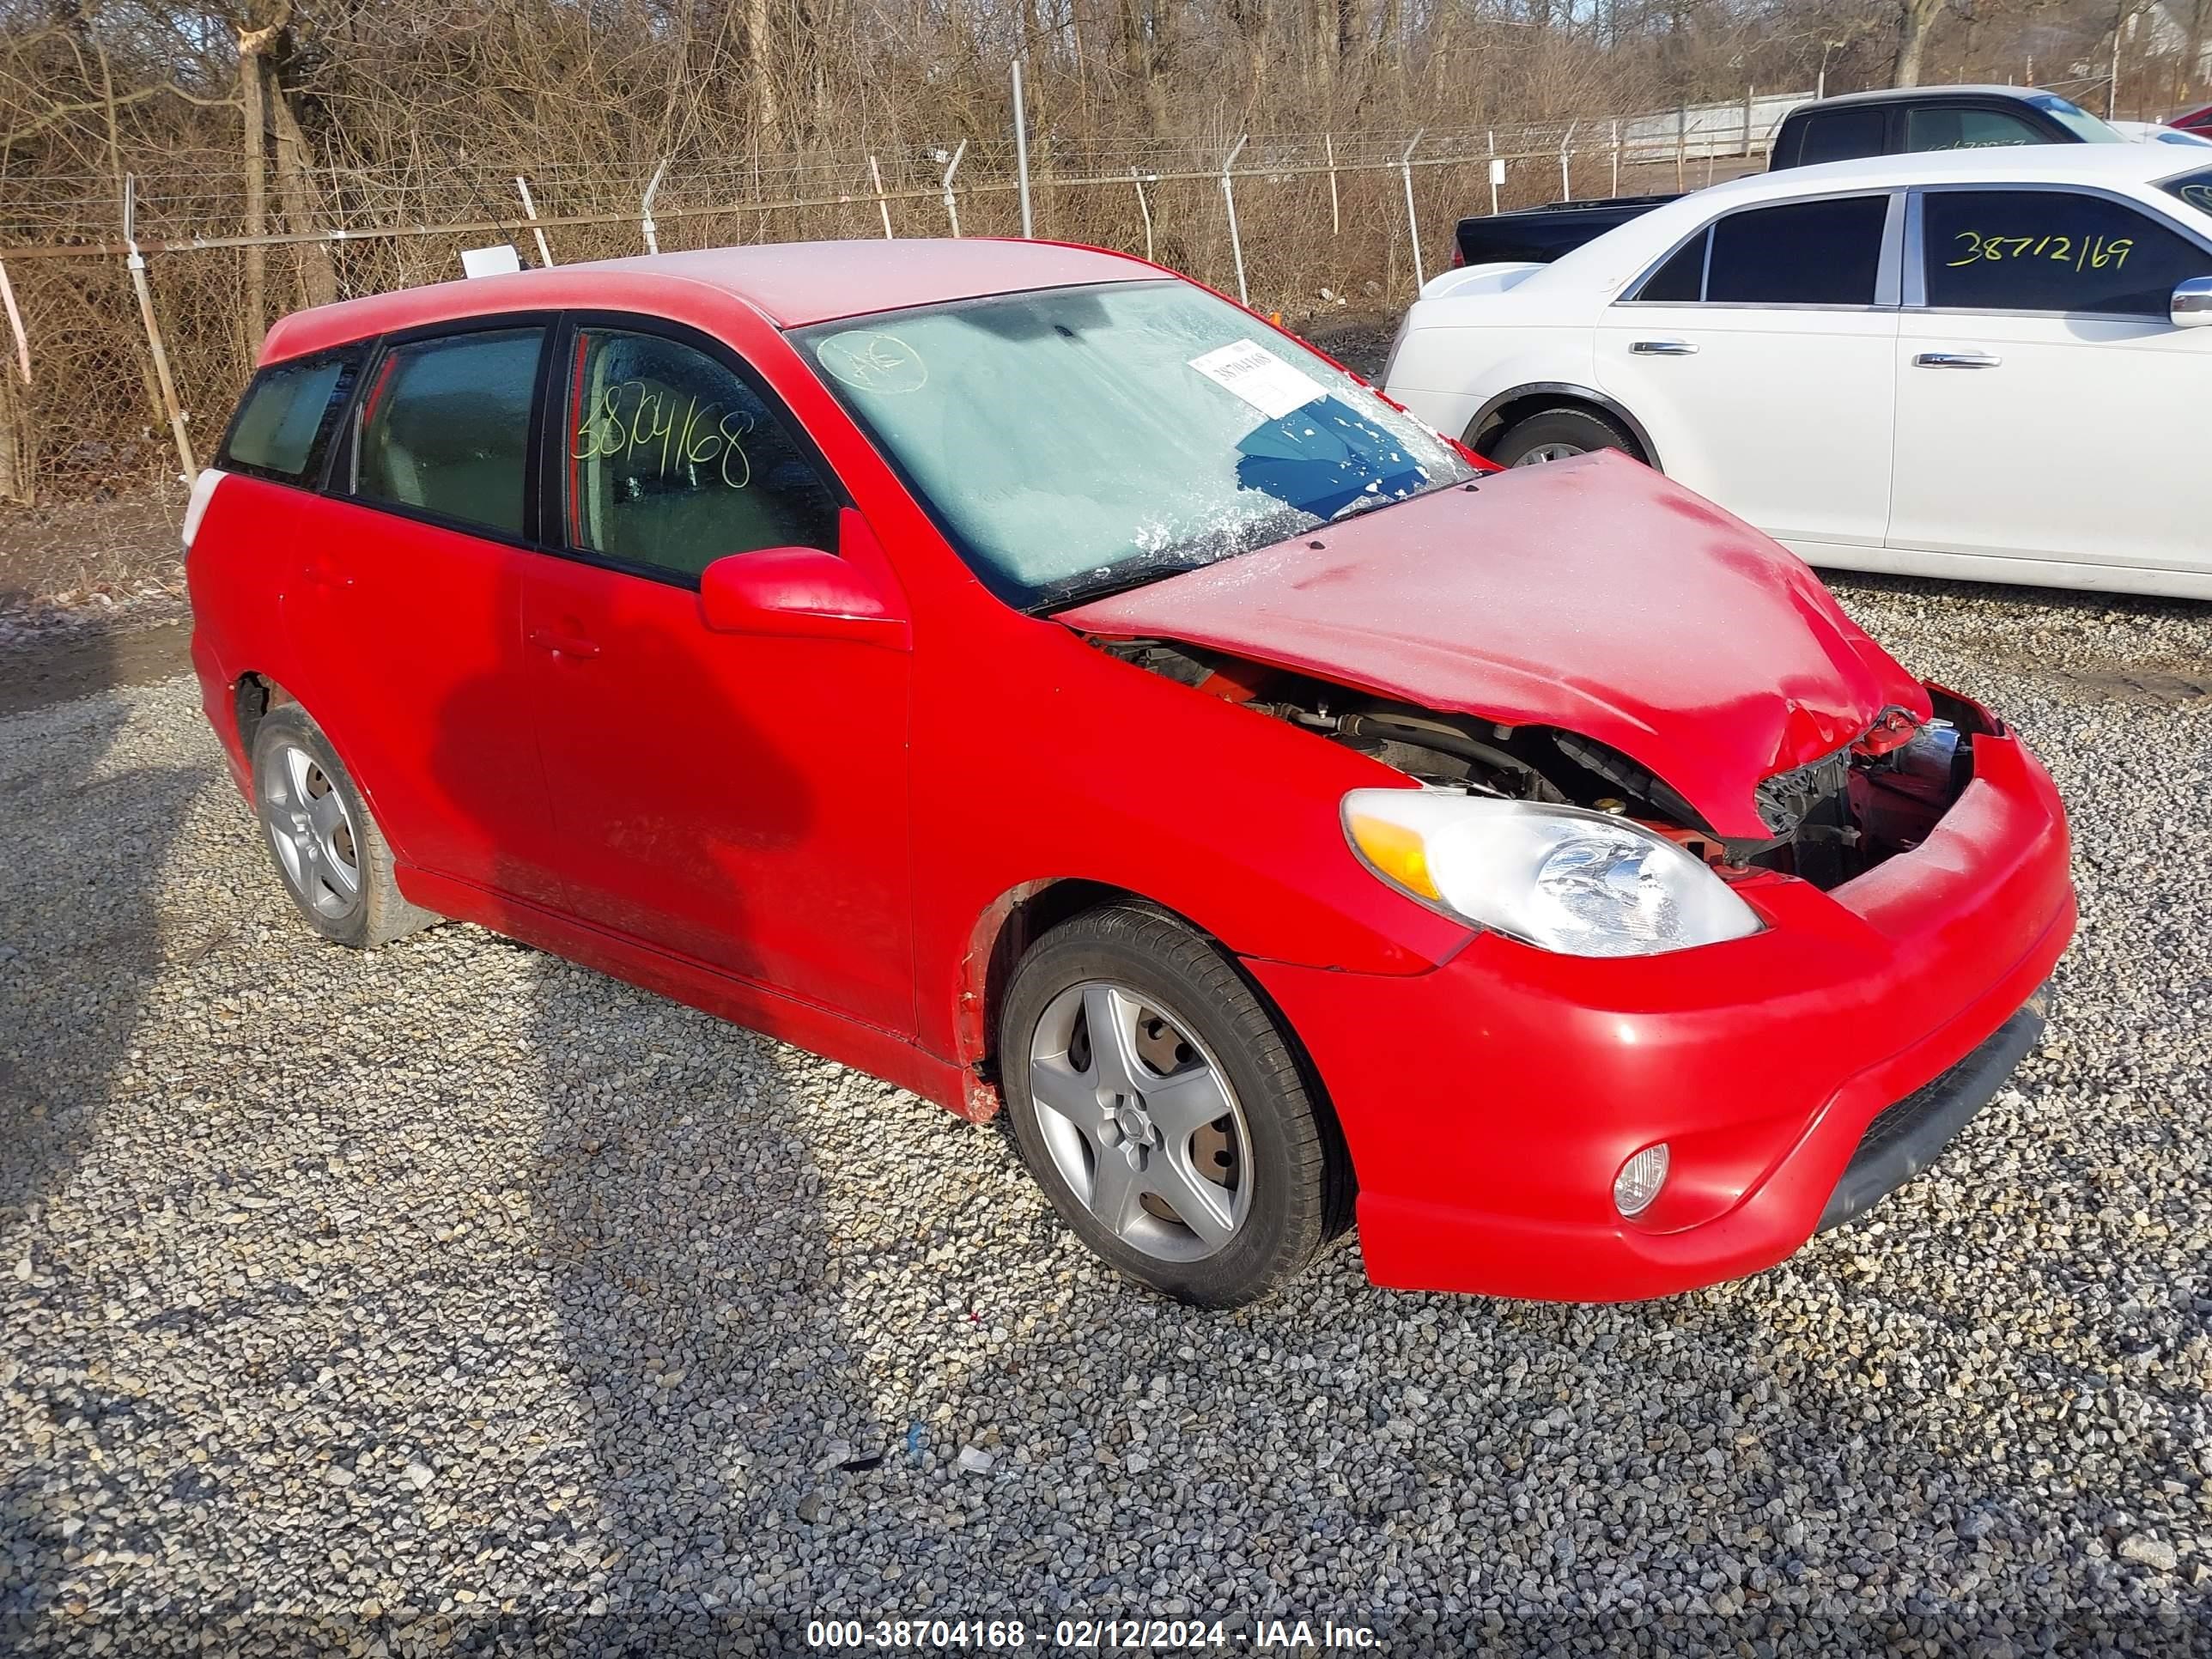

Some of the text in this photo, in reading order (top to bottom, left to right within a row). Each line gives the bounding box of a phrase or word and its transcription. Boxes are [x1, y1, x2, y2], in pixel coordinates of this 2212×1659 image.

[1946, 232, 2134, 272] 38712169
[1213, 352, 1272, 381] 38704168
[571, 381, 754, 488] 38704168
